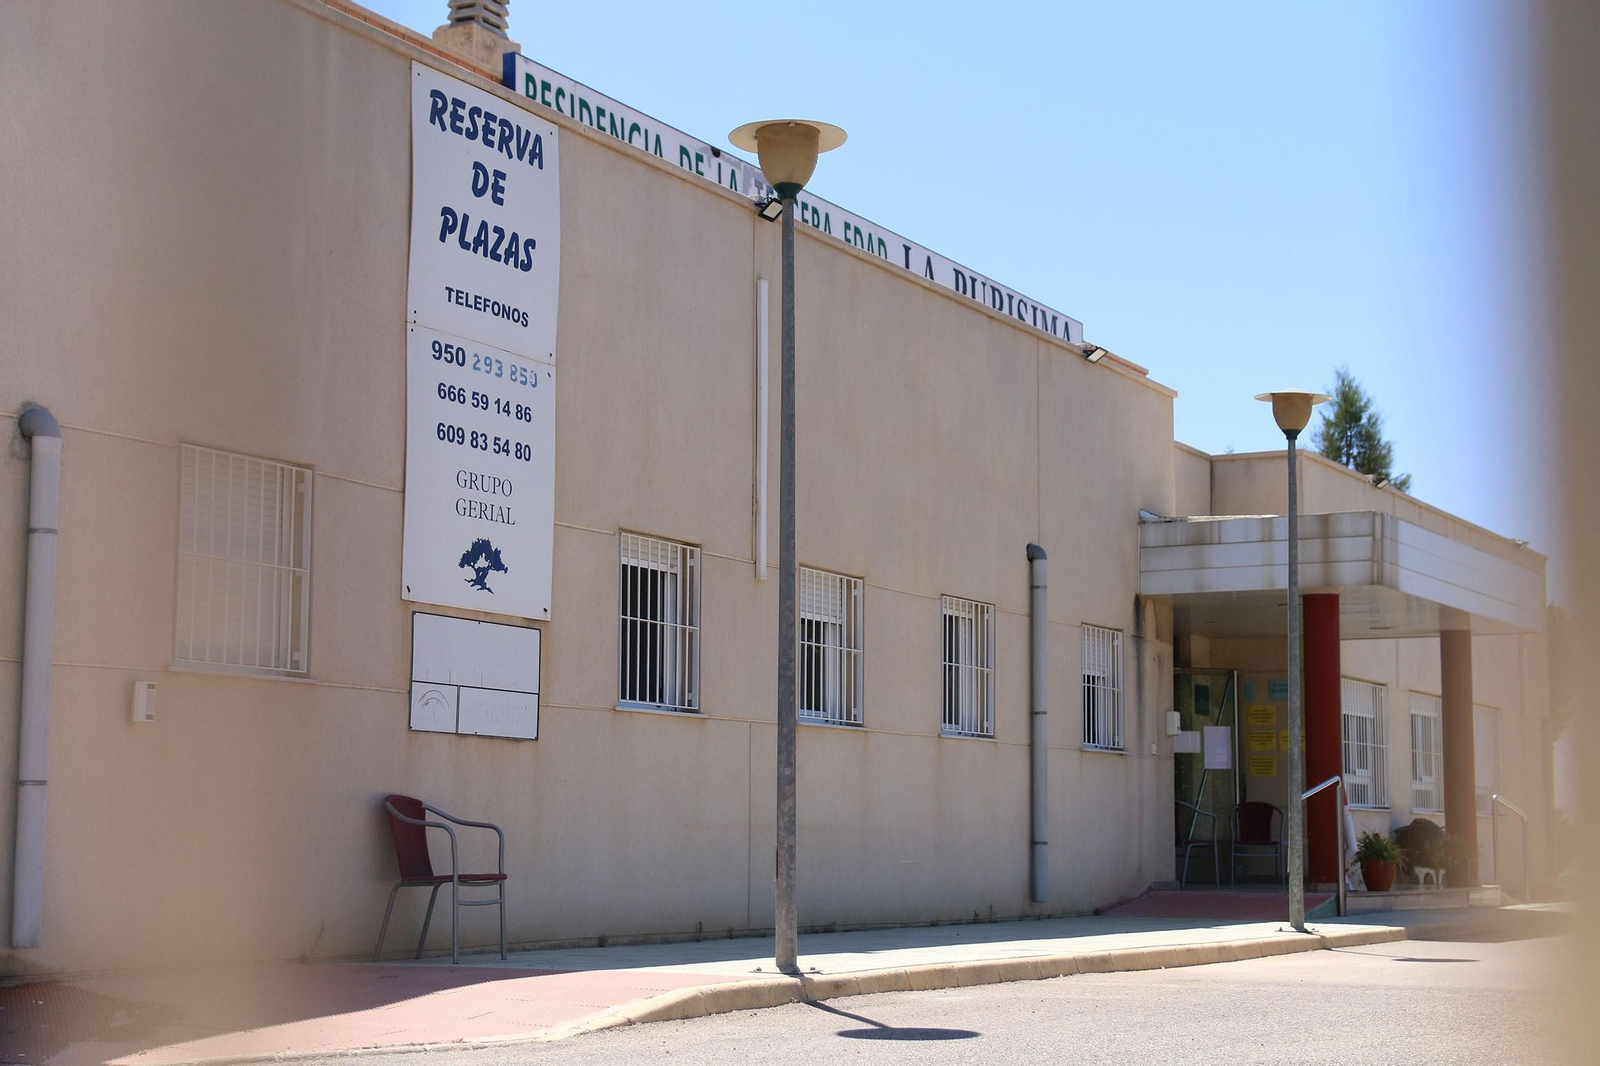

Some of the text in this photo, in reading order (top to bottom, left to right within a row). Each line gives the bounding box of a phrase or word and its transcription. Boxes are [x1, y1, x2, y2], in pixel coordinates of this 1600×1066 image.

[429, 88, 544, 170] RESERVA
[471, 160, 507, 206] DE
[439, 206, 537, 273] PLAZAS
[445, 286, 530, 328] TELEFONOS
[431, 340, 538, 389] 950 293 850
[437, 382, 532, 423] 666 59 14 86
[436, 422, 532, 462] 609 83 54 80
[456, 469, 513, 497] GRUPO
[455, 497, 515, 526] GERIAL
